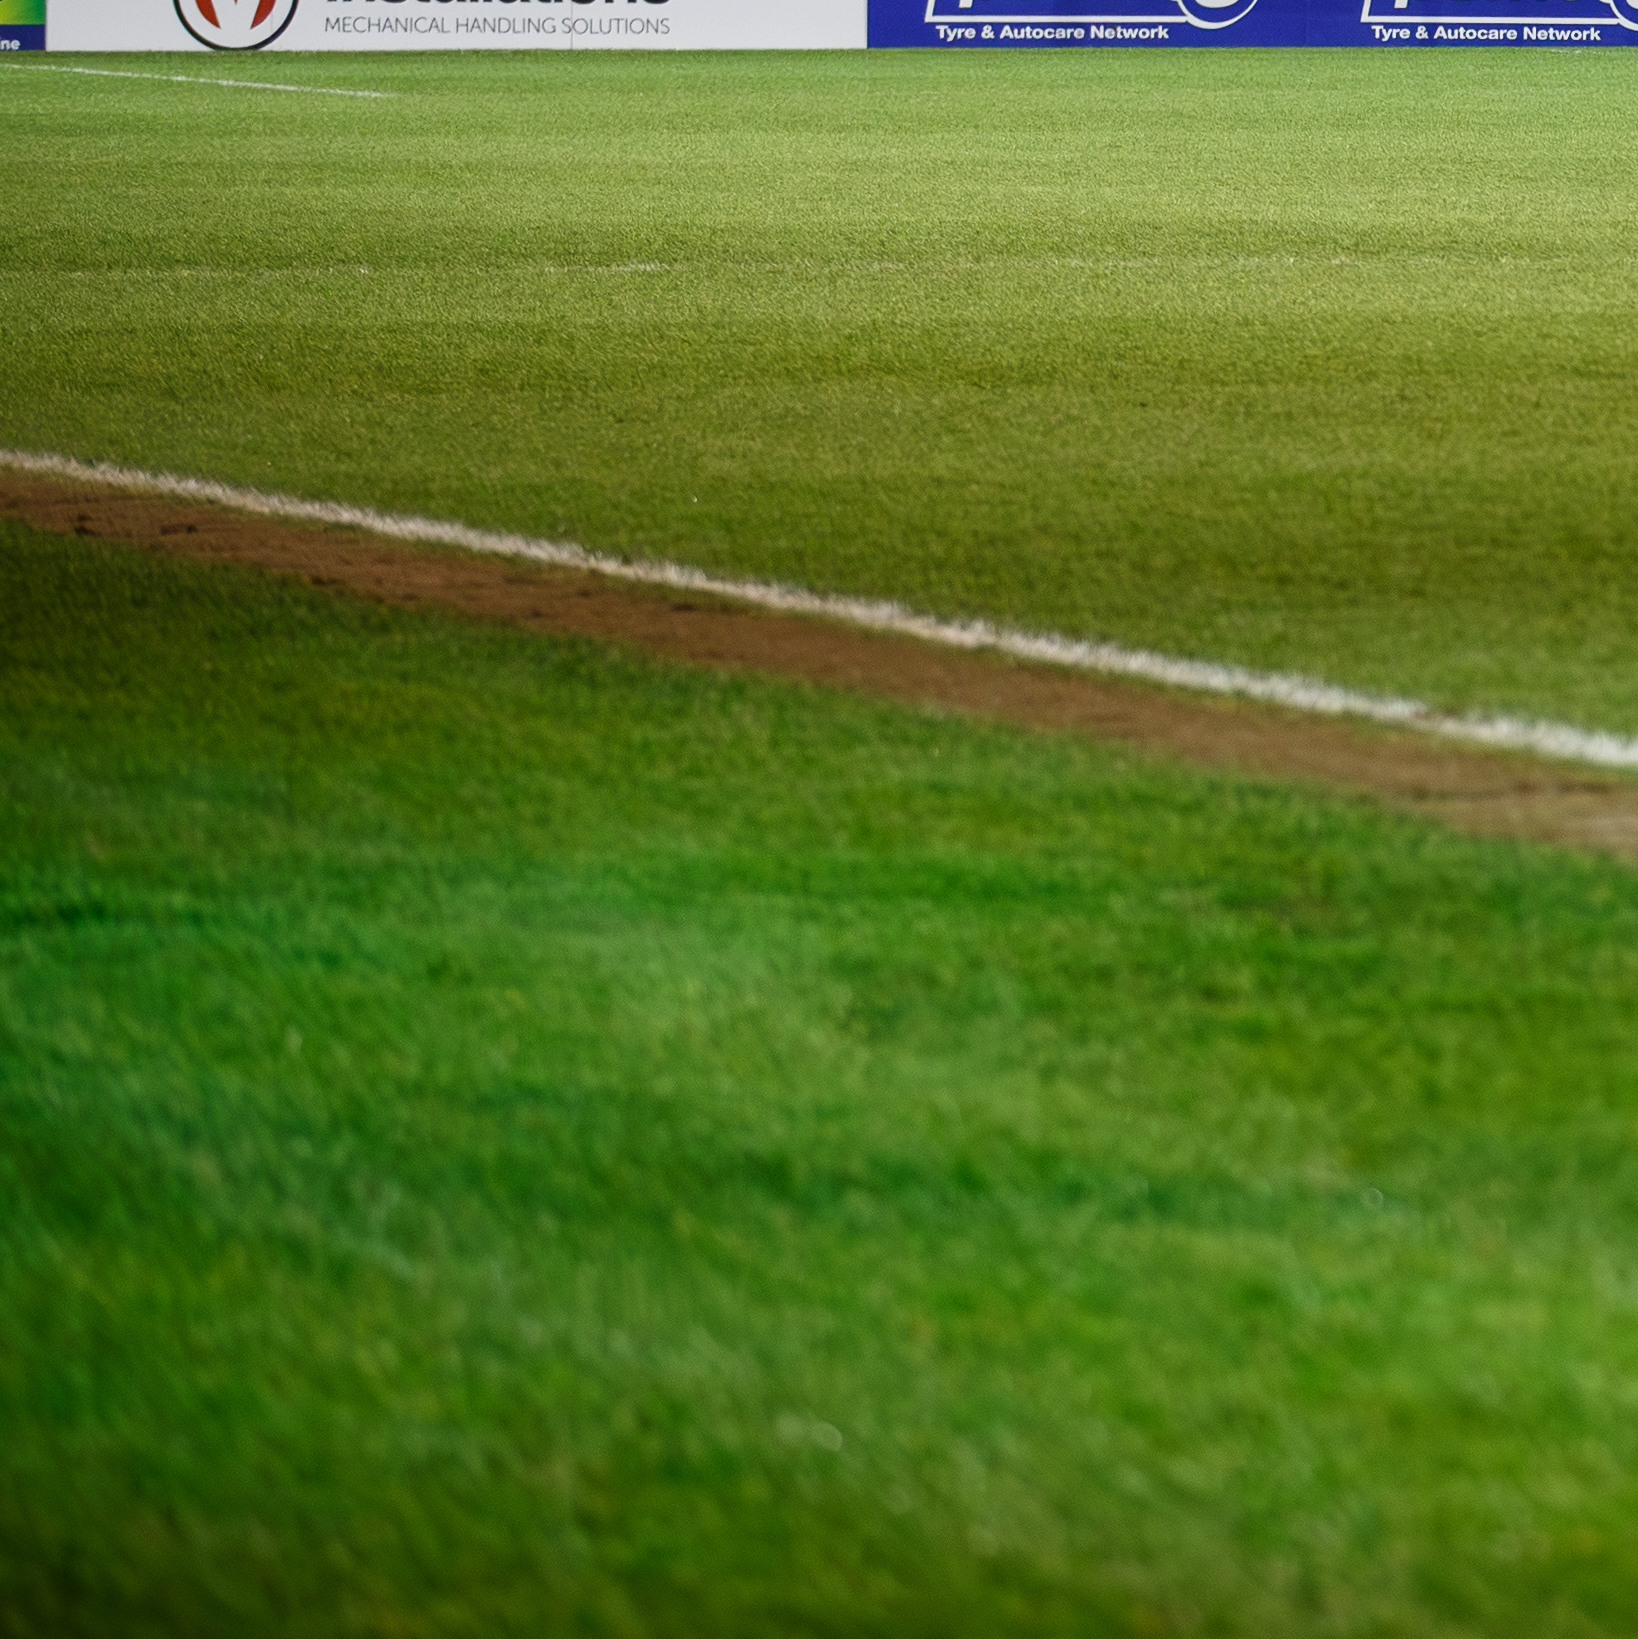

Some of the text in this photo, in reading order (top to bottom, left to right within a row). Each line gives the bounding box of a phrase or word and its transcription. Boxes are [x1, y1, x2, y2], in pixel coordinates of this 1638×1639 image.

[324, 15, 671, 36] MECHANICAL HANDLING SOLUTIONS
[935, 24, 1170, 42] Tyre & Autocare Network
[1371, 25, 1602, 42] Tyre & Autocare Network
